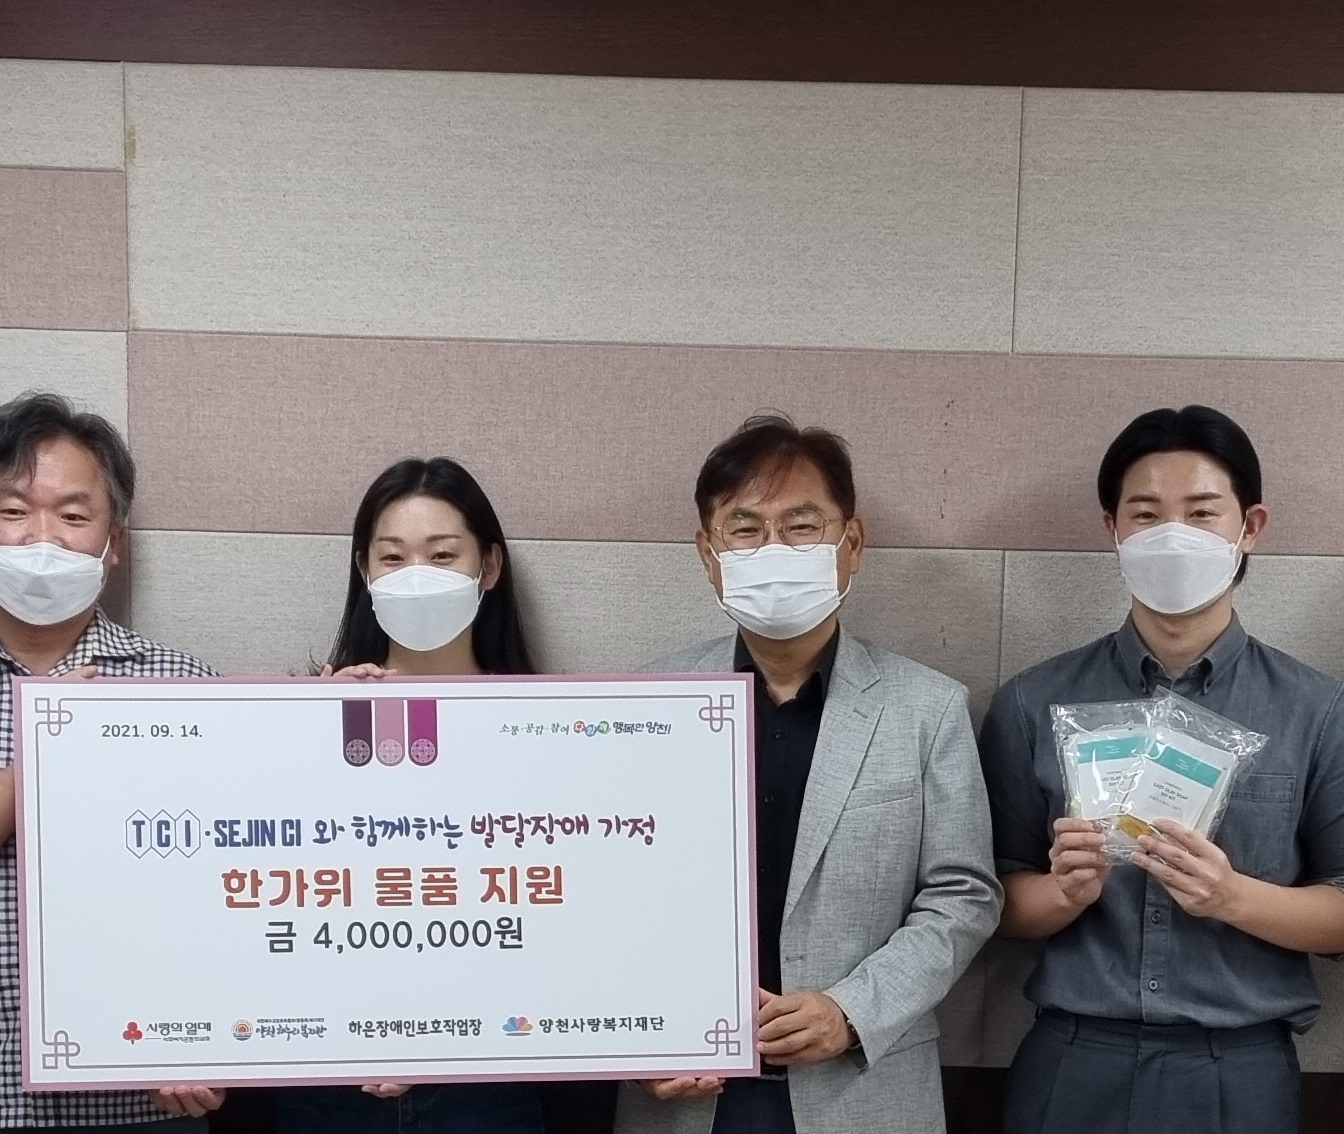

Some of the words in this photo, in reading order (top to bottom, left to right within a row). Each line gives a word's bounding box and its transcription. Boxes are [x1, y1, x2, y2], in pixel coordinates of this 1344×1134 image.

[101, 724, 145, 738] 2021.
[150, 724, 174, 738] 09.
[180, 724, 203, 738] 14.
[128, 815, 196, 852] TCI
[312, 818, 346, 845] 와
[350, 814, 464, 850] 함께하는
[470, 812, 590, 849] 발달장애
[597, 813, 656, 846] 가정
[220, 867, 353, 909] 한가위
[374, 866, 458, 907] 물품
[479, 864, 565, 906] 지원
[264, 920, 298, 954] 금
[312, 916, 524, 954] 4,000,000원
[145, 1021, 184, 1036] 사랑의
[184, 1021, 212, 1036] 열매
[347, 1018, 483, 1038] 하은장애인보호작업장
[538, 1015, 666, 1034] 양천사랑복지재단
